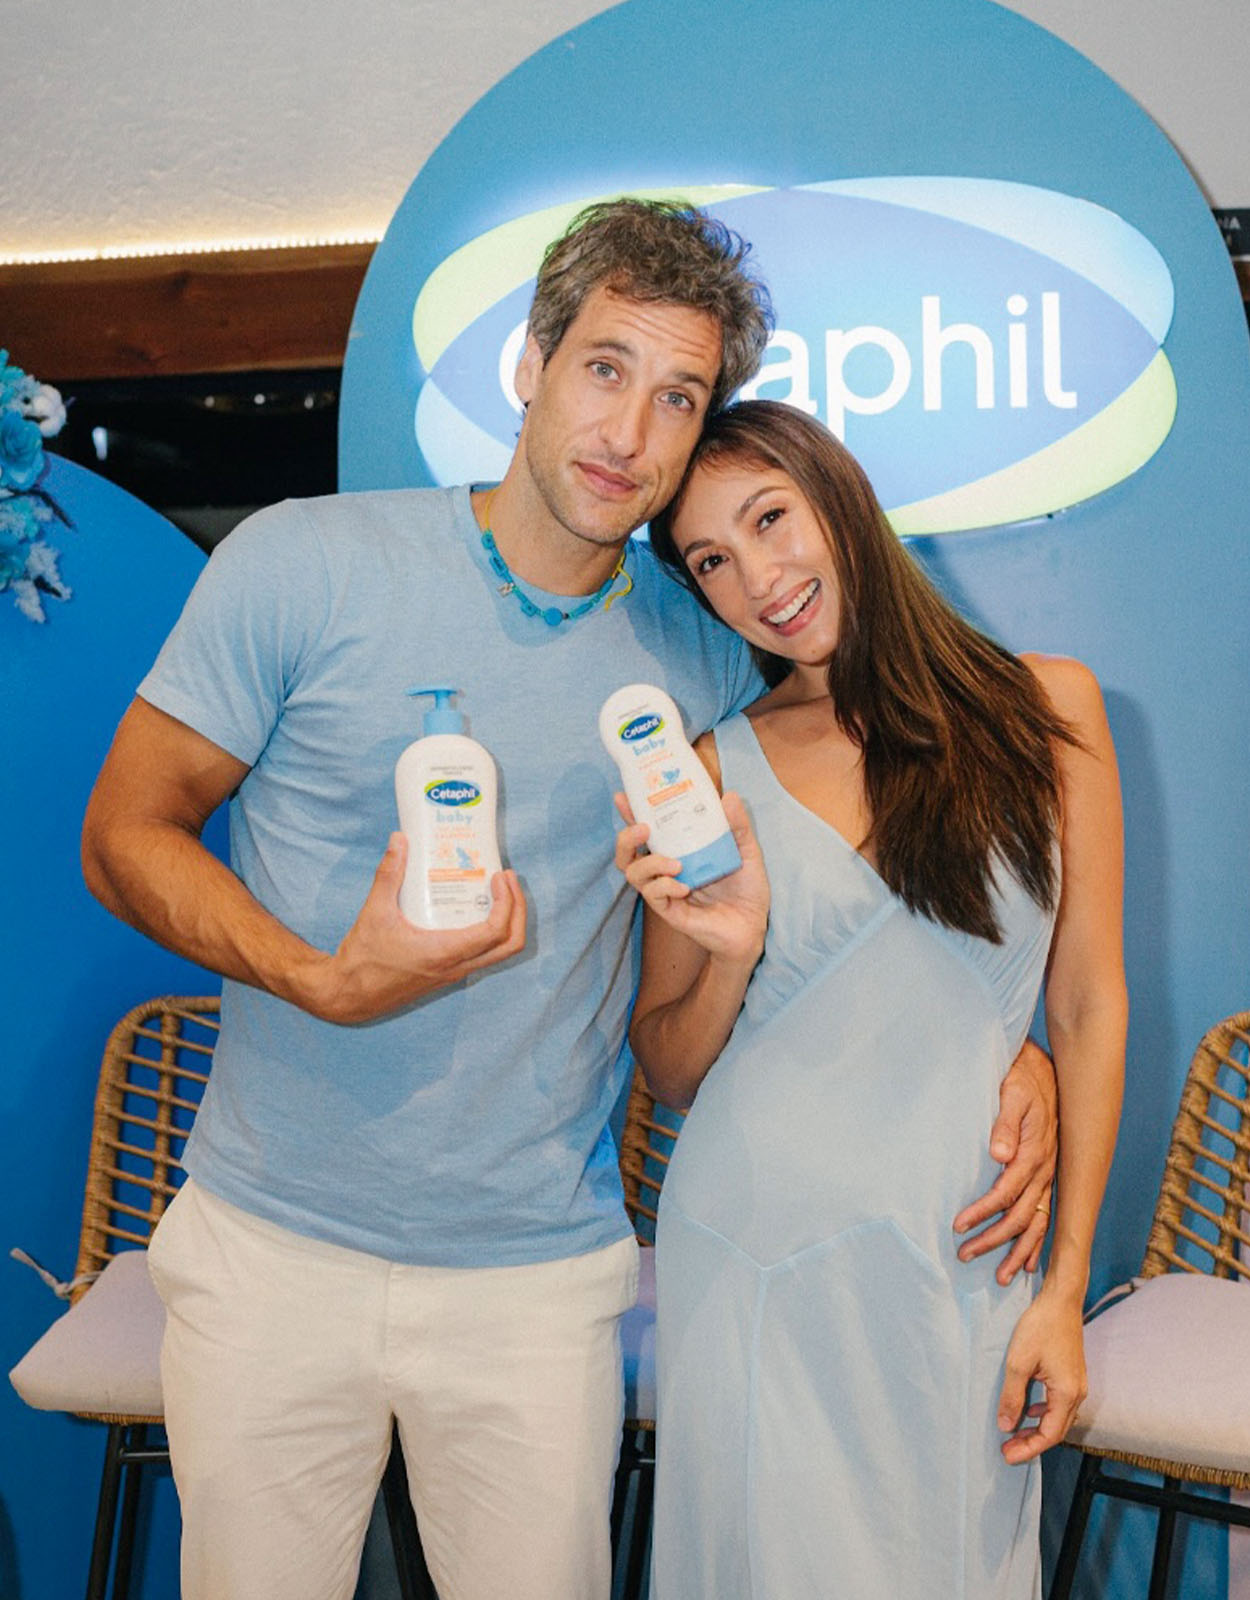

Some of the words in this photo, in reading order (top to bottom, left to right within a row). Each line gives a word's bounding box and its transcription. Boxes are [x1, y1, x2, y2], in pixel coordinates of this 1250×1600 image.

[498, 292, 1078, 444] aphil
[623, 716, 662, 739] Cetaphil
[632, 736, 666, 756] baby
[430, 787, 476, 801] Cetaphil
[435, 809, 473, 825] baby
